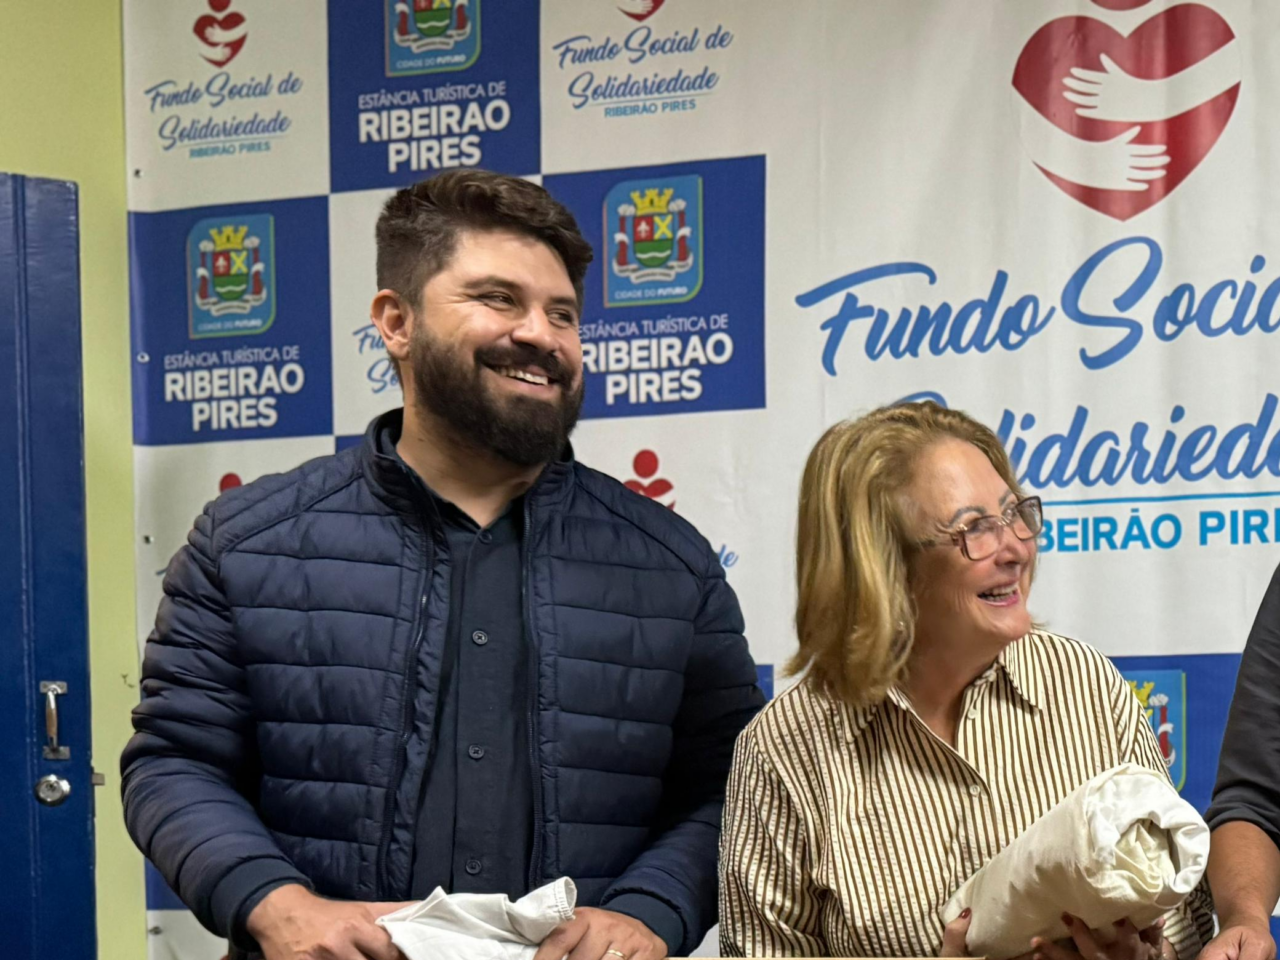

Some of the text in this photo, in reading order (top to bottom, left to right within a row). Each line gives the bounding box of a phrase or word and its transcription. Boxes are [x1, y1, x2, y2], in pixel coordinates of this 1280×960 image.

[552, 24, 734, 69] Fundo Social de
[144, 71, 303, 113] Fundo Social de
[358, 81, 506, 109] ESTÂNCIA TURÍSTICA DE
[568, 65, 720, 109] Solidariedade
[358, 99, 511, 143] RIBEIRAO
[604, 99, 696, 118] RIBEIRÃO PIRES
[159, 110, 292, 151] Solidariedade
[388, 135, 482, 173] PIRES
[578, 313, 728, 340] ESTÂNCIA TURÍSTICA DE
[794, 261, 1057, 377] Fundo
[164, 345, 299, 370] ESTÂNCIA TURÍSTICA DE
[582, 331, 734, 374] RIBEIRAO
[164, 363, 305, 402] RIBEIRAO
[606, 368, 703, 406] PIRES
[192, 396, 278, 432] PIRES
[1038, 508, 1182, 553] BEIRÃO
